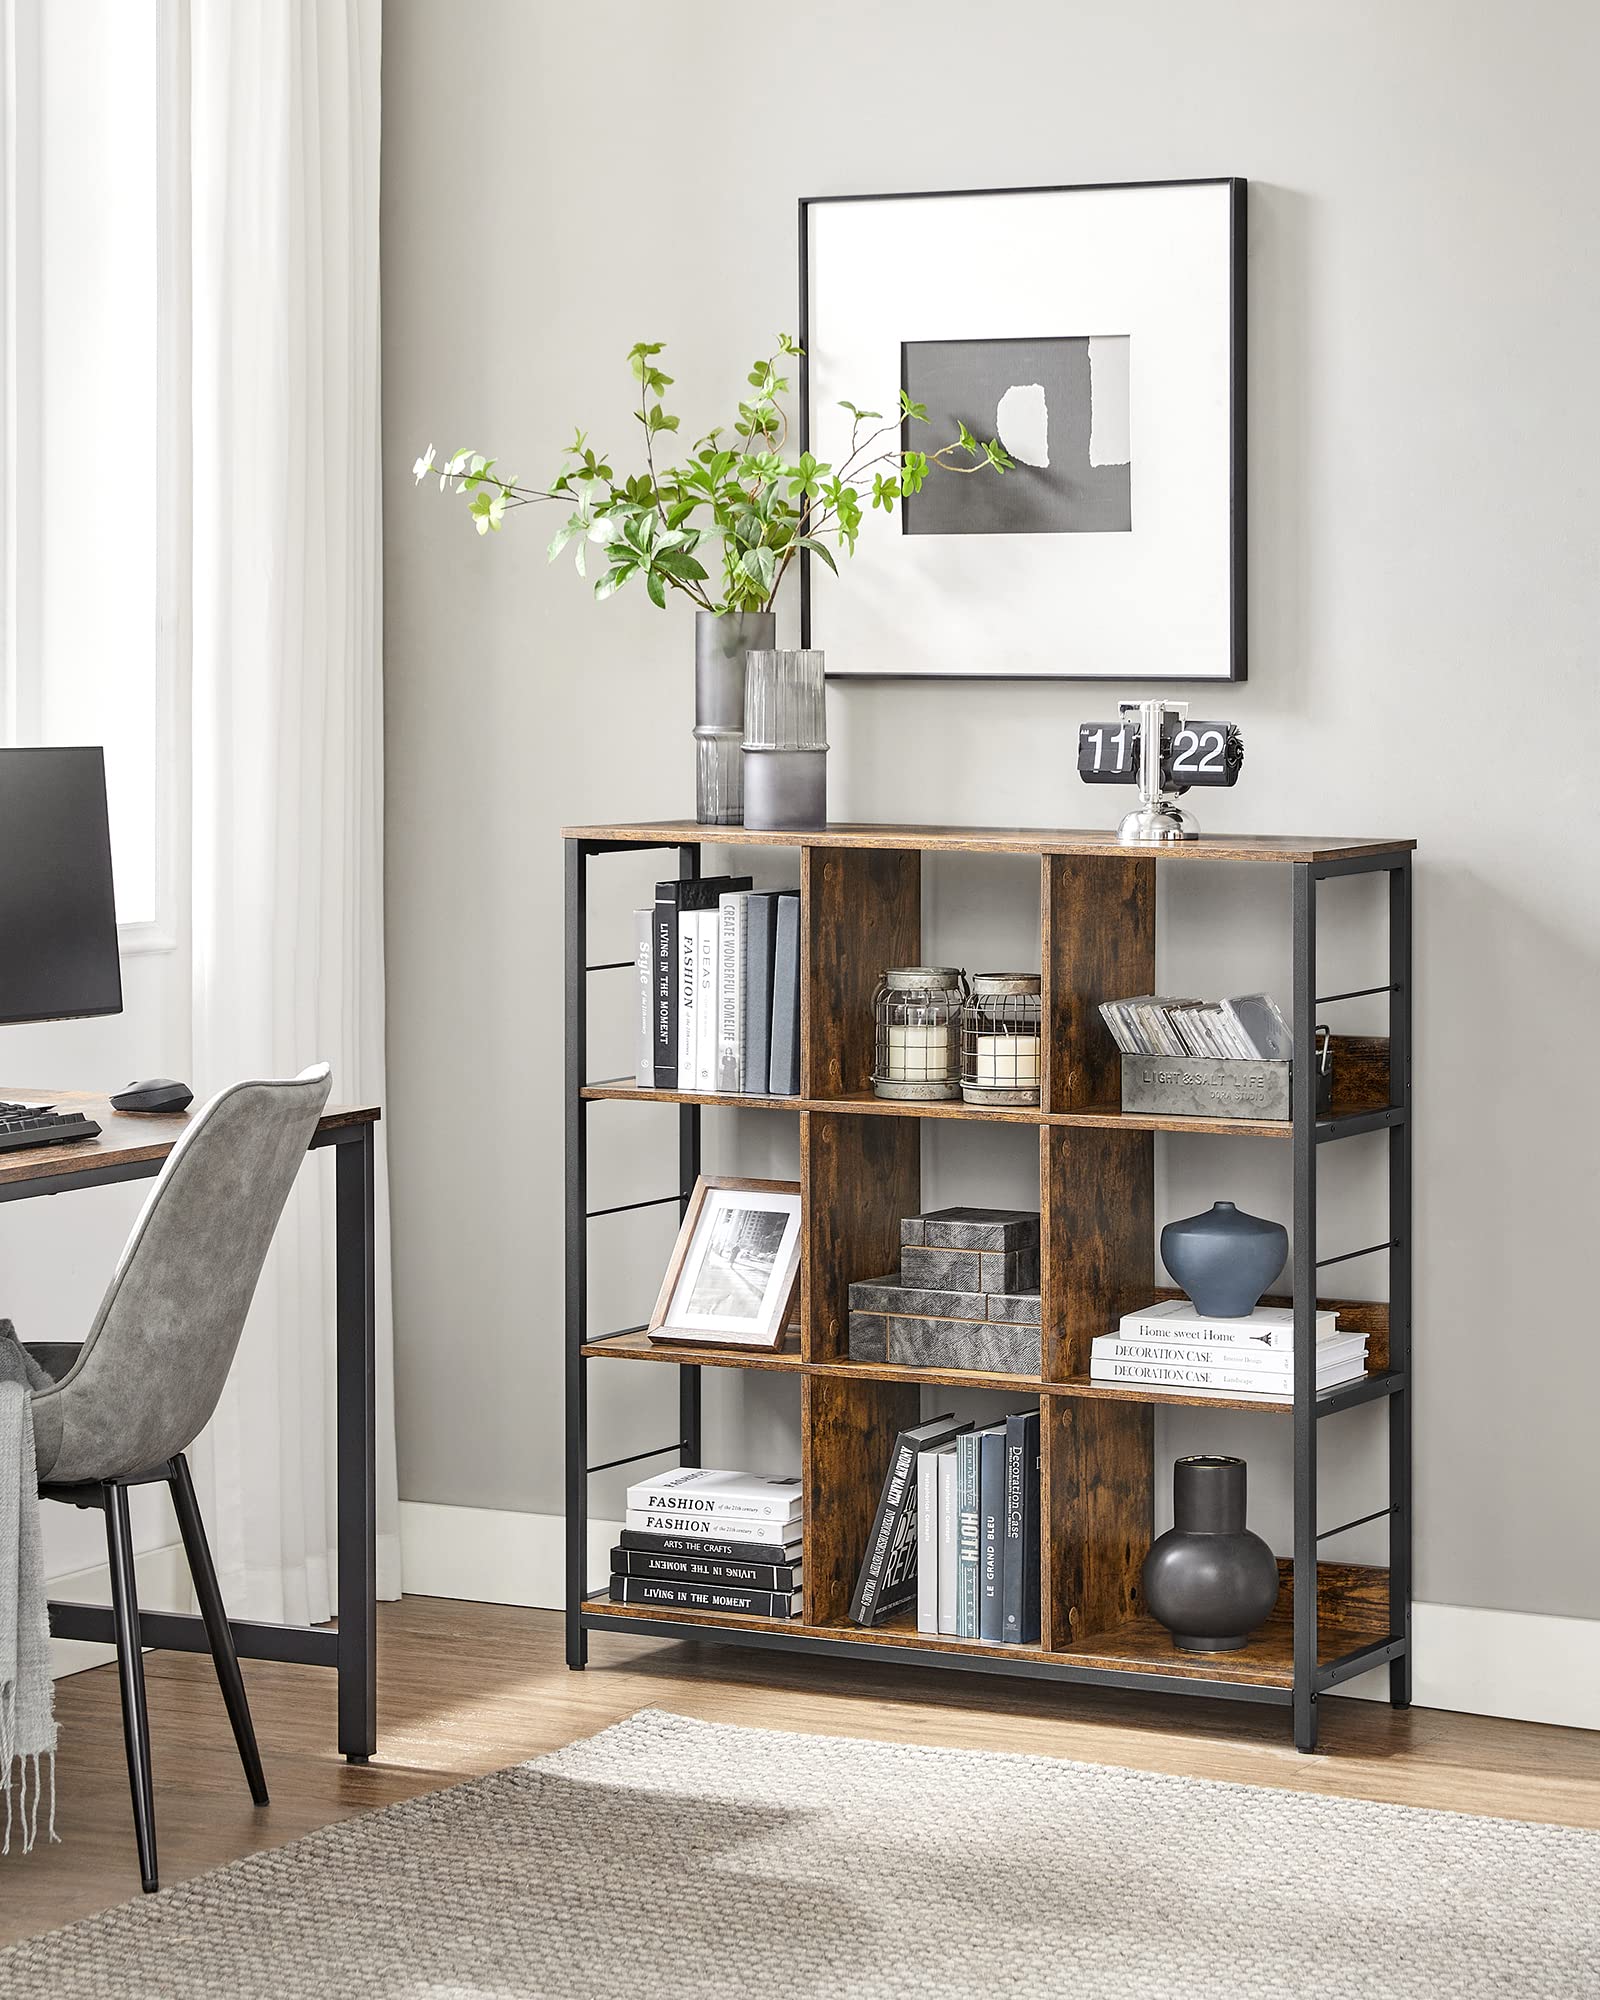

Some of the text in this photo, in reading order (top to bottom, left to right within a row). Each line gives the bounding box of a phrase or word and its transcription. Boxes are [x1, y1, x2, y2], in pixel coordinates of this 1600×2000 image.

[1087, 729, 1225, 773] 11 22
[635, 941, 650, 985] Style
[684, 935, 694, 1009] FASHION
[702, 939, 710, 990] IDEAS
[724, 904, 735, 1042] CREATE WONDERFUL HOMELIFE
[660, 923, 669, 1045] LIVING IN THE MOMENT
[1234, 1074, 1265, 1088] LIFE
[1139, 1324, 1236, 1343] Home sweet Home
[1115, 1344, 1185, 1362] DECORATION
[1187, 1350, 1214, 1364] CASE
[1114, 1364, 1184, 1381] DECORATION
[1186, 1369, 1213, 1383] CASE
[894, 1445, 914, 1480] ANDREW
[648, 1496, 716, 1512] FASHION
[886, 1476, 906, 1507] MARTIN
[1011, 1446, 1023, 1539] Decoration Case
[646, 1517, 711, 1533] FASHION
[961, 1512, 979, 1562] HOTH
[663, 1540, 732, 1554] ARTS THE CRAFTS
[986, 1515, 995, 1597] LE GRAND BLEU
[649, 1559, 757, 1580] LIVING IN THE MOMENT
[868, 1553, 884, 1578] REVIEW
[643, 1588, 752, 1609] LIVING IN THE MOMENT
